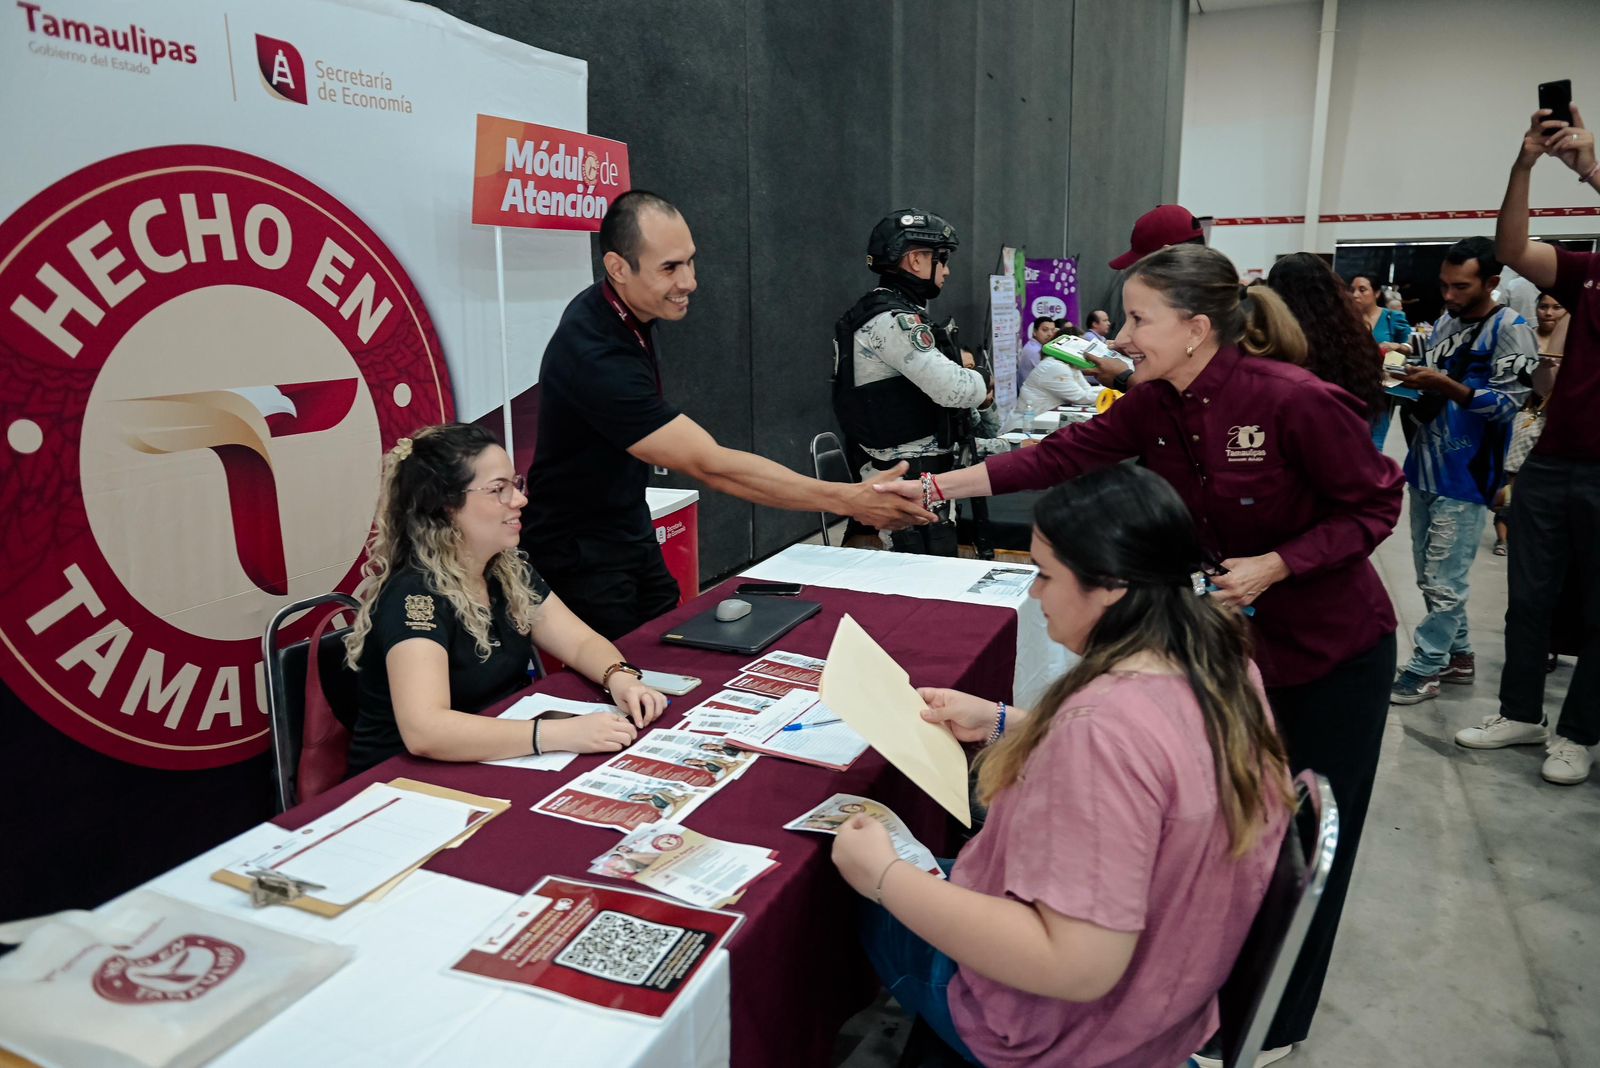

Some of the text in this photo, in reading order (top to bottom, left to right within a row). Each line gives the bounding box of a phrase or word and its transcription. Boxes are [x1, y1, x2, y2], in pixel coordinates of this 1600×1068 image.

[17, 1, 198, 65] Tamaulipas
[28, 40, 151, 75] Gobierno del Estado
[314, 60, 393, 91] Secretaría
[317, 82, 413, 114] de Economía
[600, 152, 619, 186] de
[500, 178, 609, 219] Atención
[10, 193, 393, 360] HECHO EN
